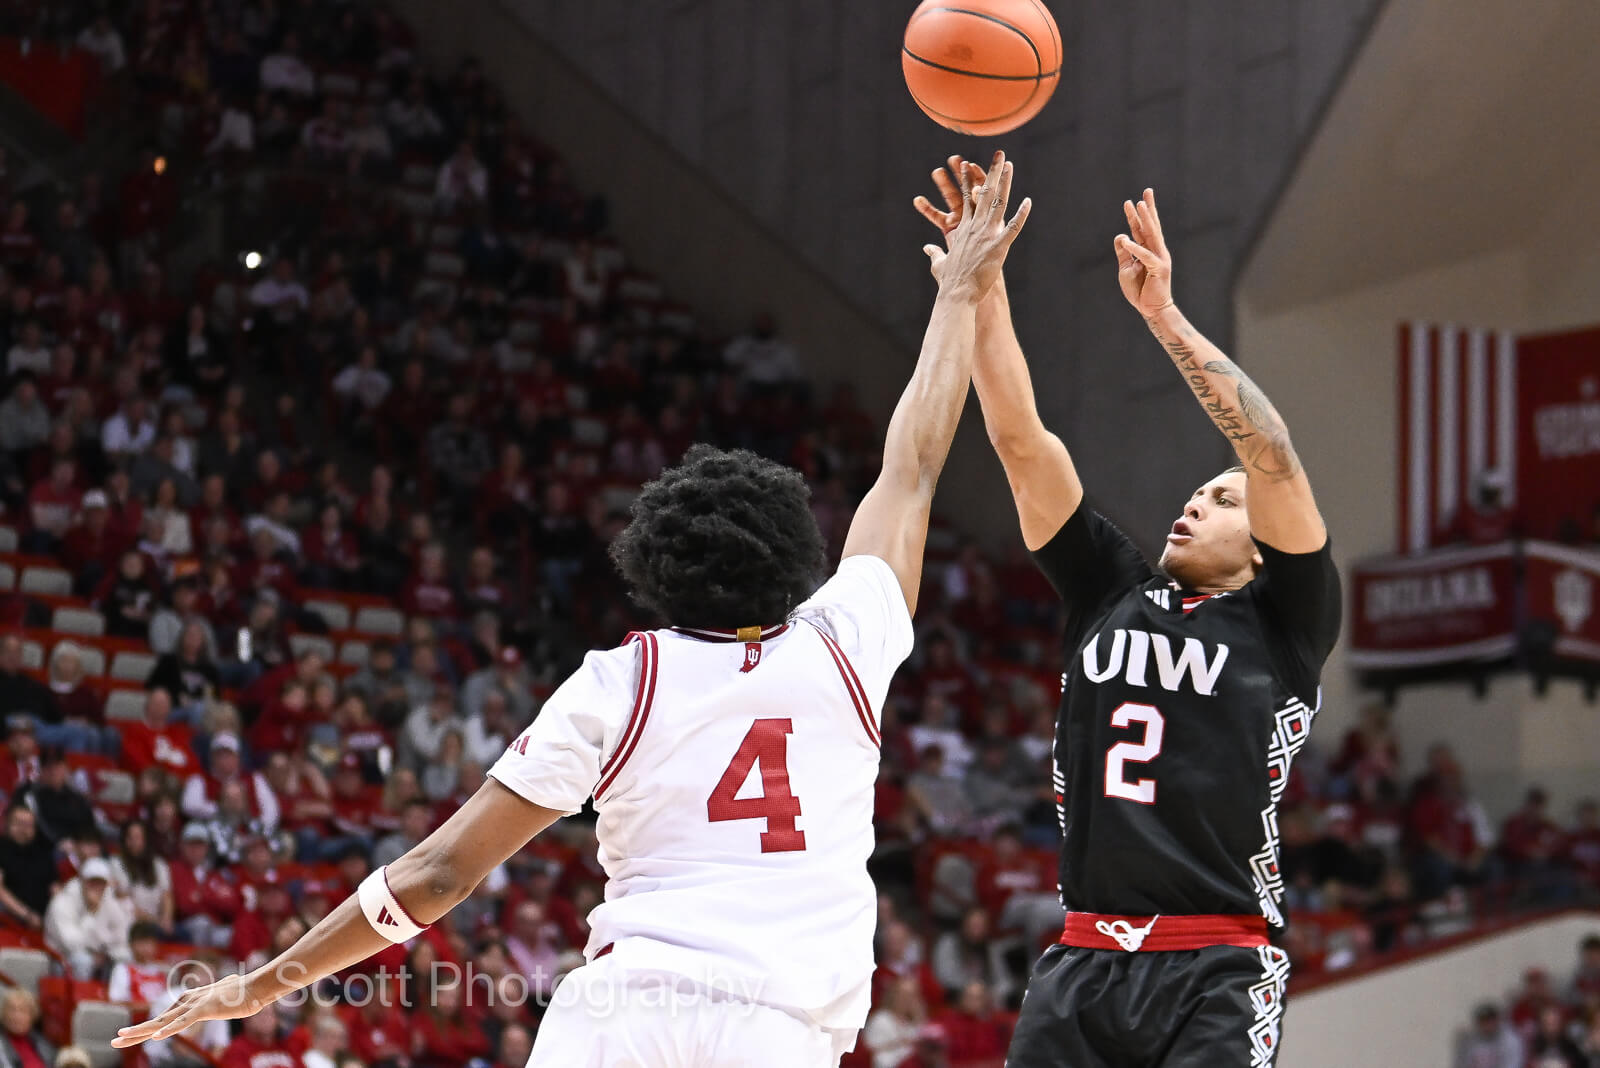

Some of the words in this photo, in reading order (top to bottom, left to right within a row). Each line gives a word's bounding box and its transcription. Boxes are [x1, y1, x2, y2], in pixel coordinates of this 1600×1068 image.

[1082, 628, 1230, 697] UIW
[707, 717, 806, 854] 4
[1104, 700, 1166, 806] 2
